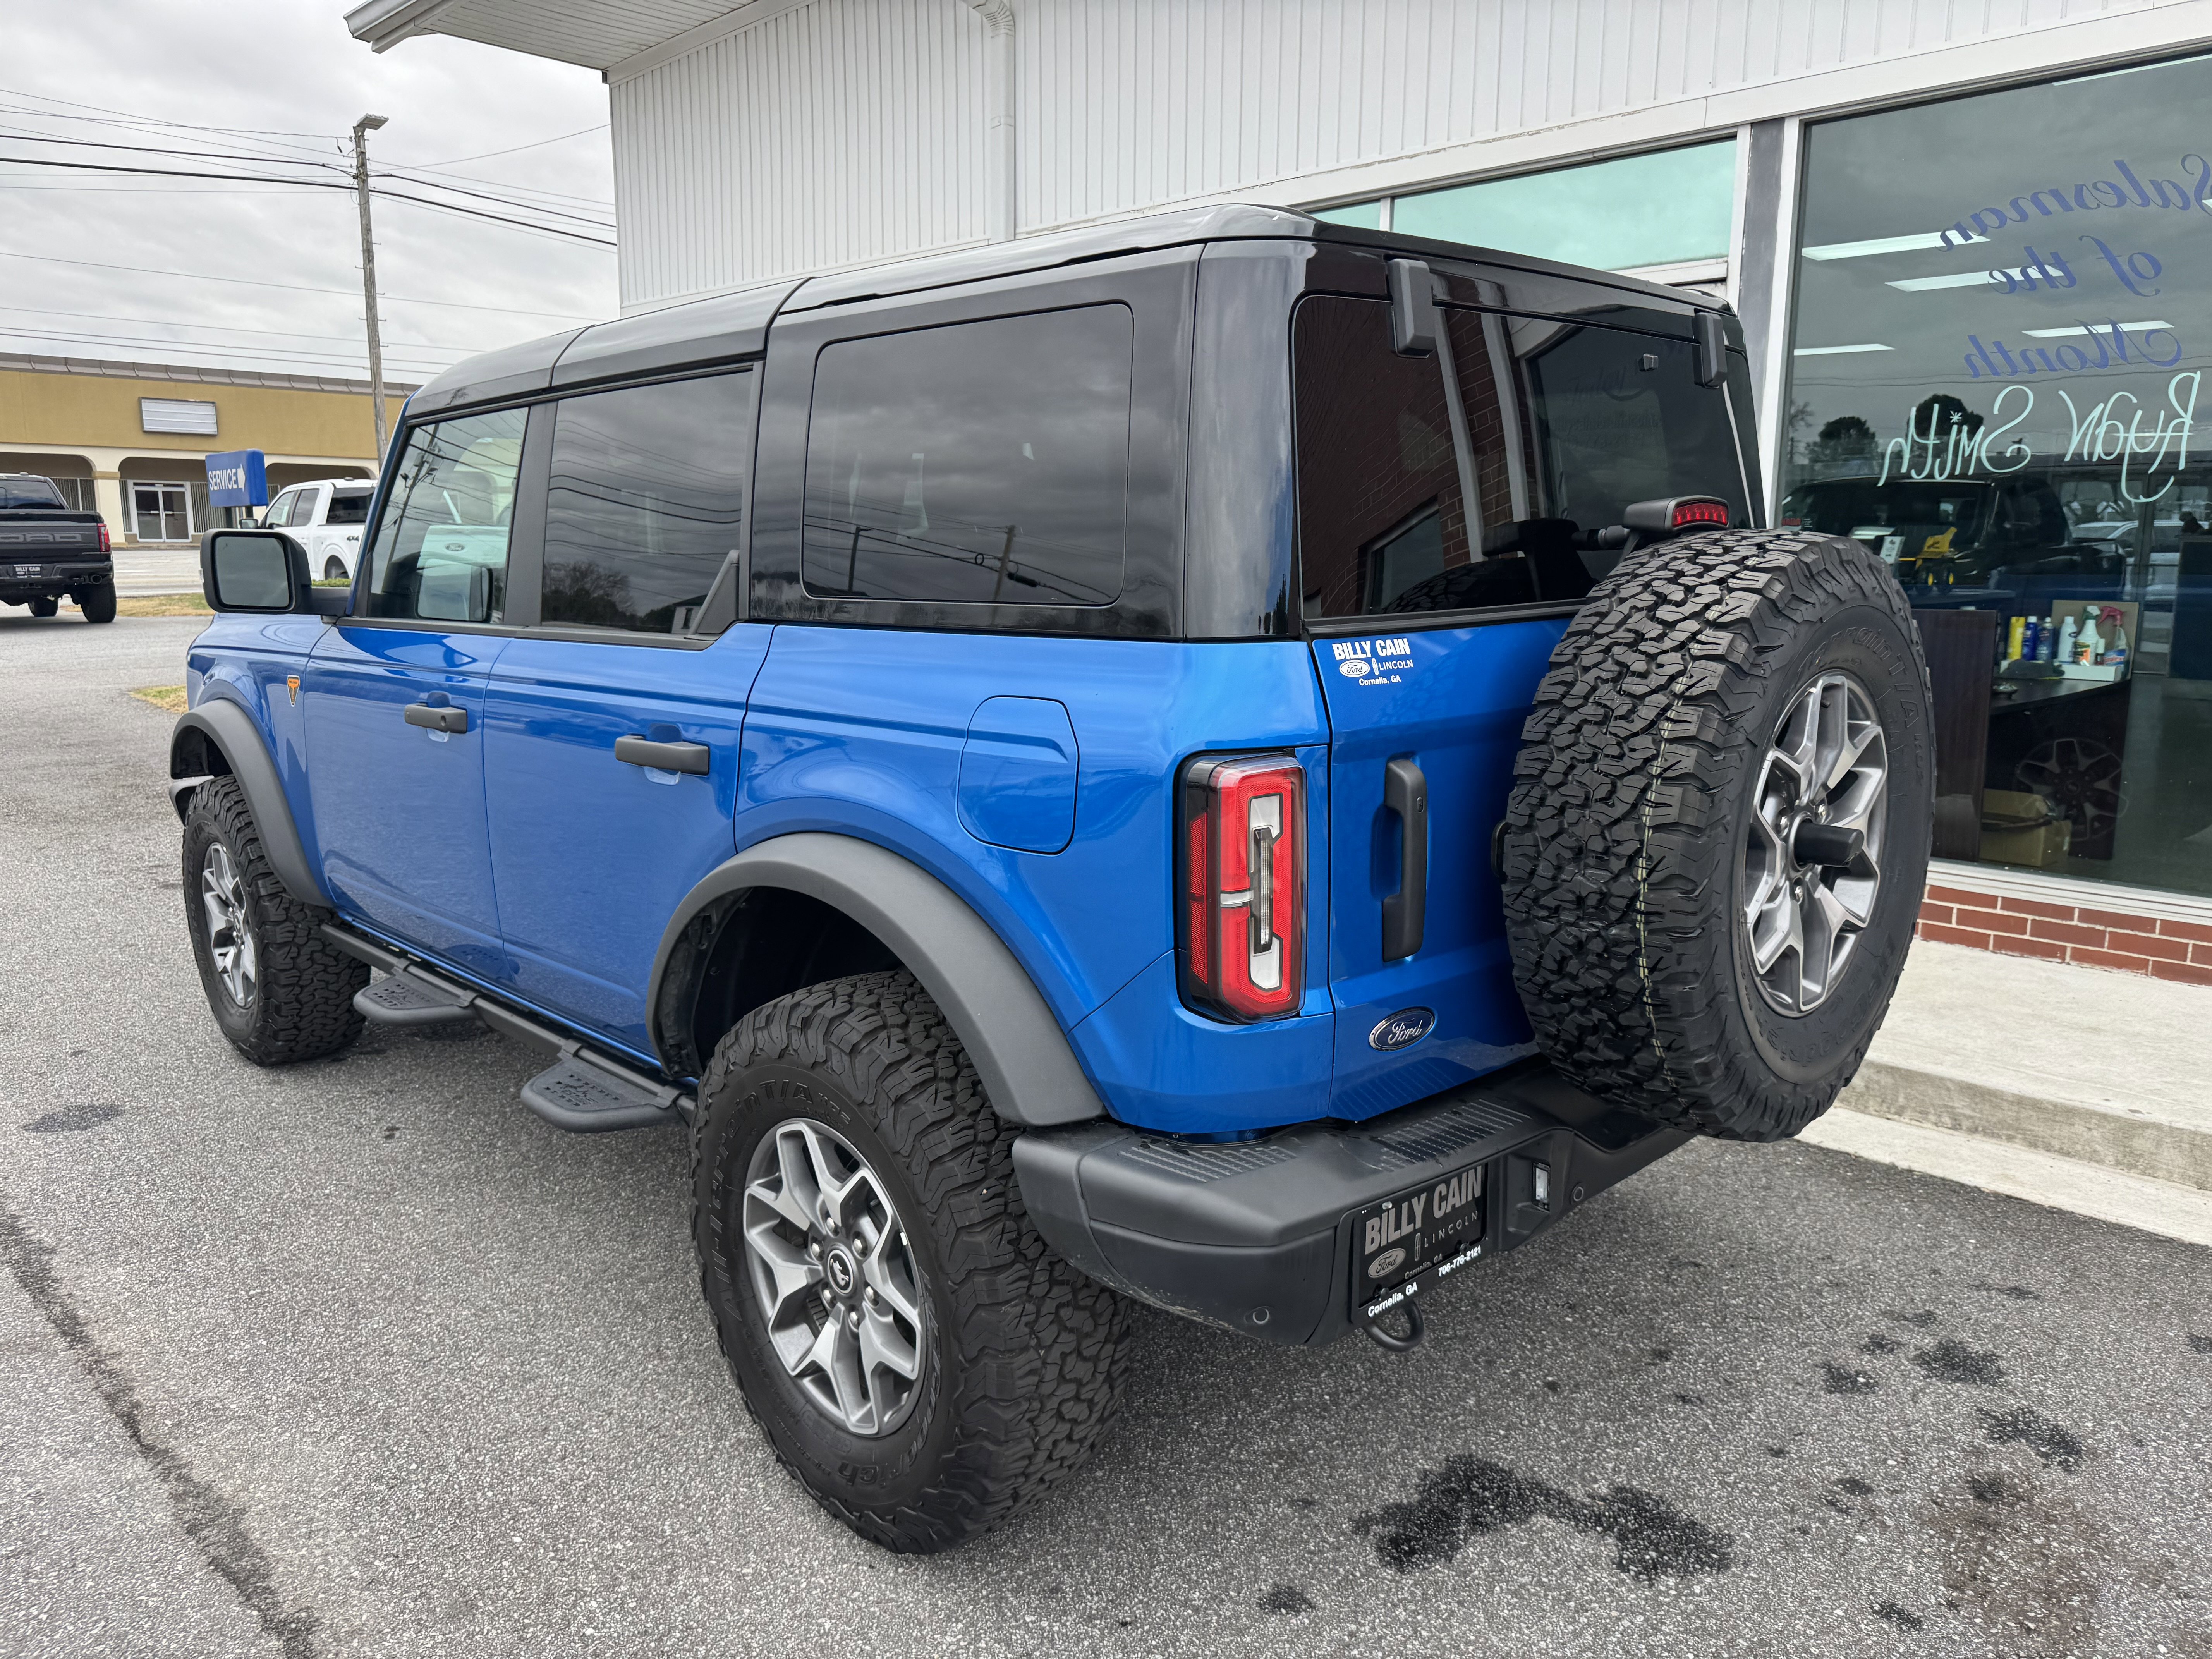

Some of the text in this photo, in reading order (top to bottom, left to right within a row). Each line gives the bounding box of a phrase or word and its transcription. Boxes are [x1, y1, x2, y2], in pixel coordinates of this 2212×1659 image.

[208, 468, 237, 491] SERVICE
[1332, 638, 1411, 660] BILLY CAIN
[1347, 659, 1413, 673] Ford LINCOLN
[1391, 675, 1401, 683] GA
[1388, 1018, 1422, 1044] Ford
[1365, 1165, 1482, 1255] BILLY CAIN
[1376, 1211, 1478, 1273] Ford LINCOLN
[1434, 1253, 1443, 1263] GA
[1438, 1245, 1481, 1277] 706-778-2121
[1405, 1281, 1418, 1296] GA
